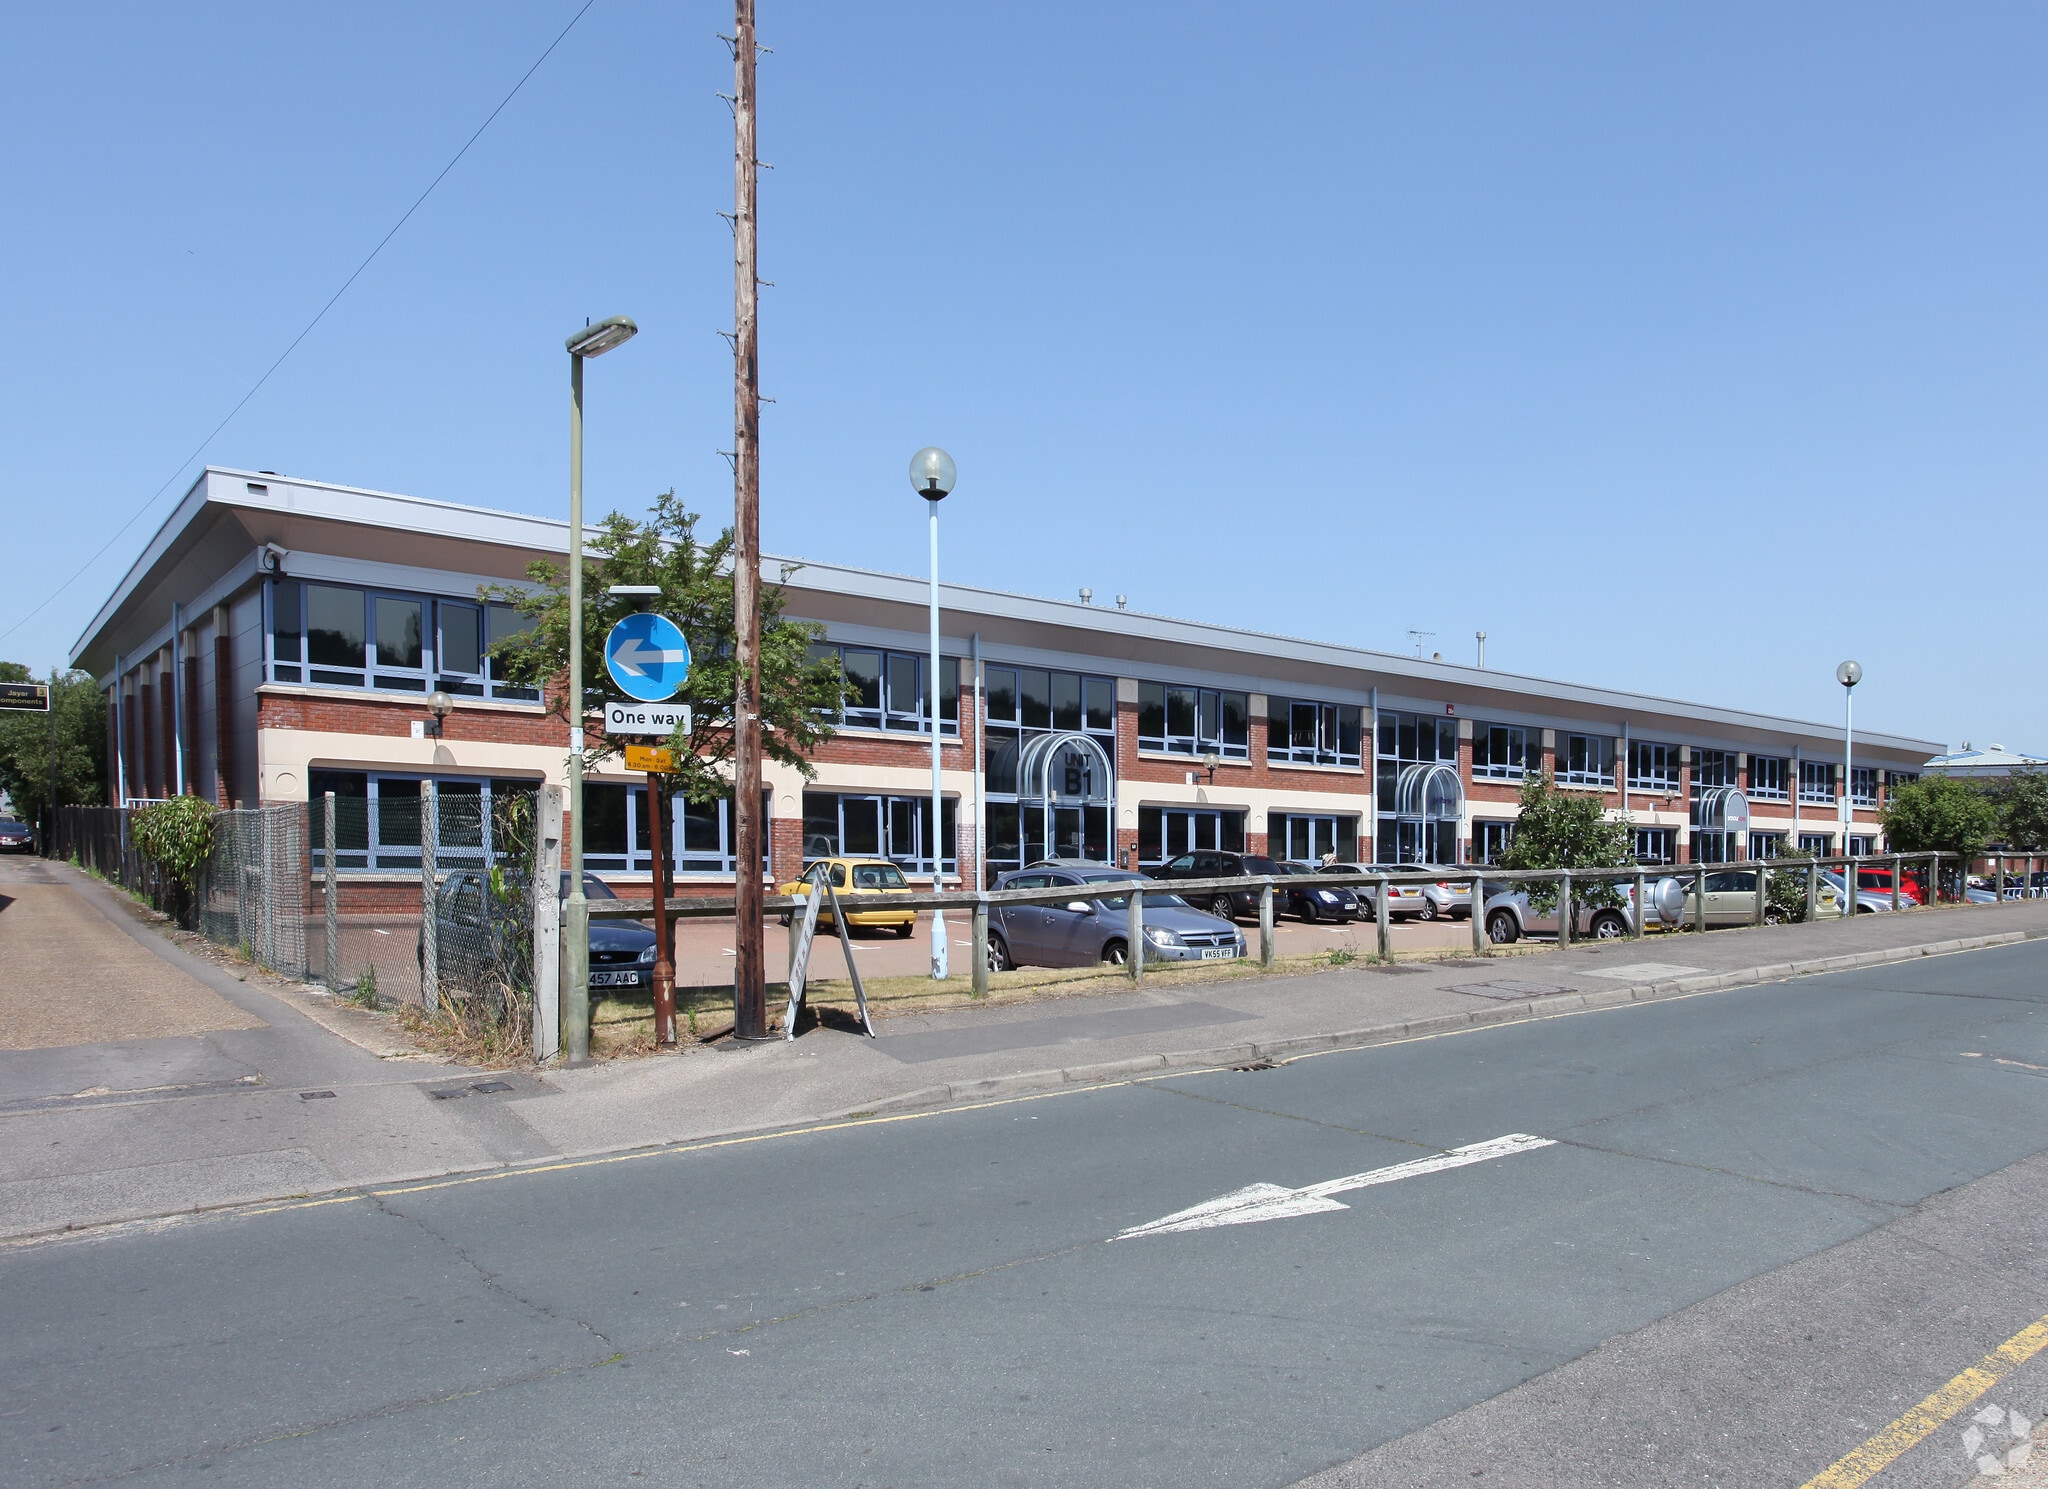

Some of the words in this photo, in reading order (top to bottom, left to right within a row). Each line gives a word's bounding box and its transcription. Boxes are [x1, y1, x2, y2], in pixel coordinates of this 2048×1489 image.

[612, 710, 645, 723] One
[1065, 753, 1090, 766] UNIT
[1065, 768, 1091, 795] B1
[590, 974, 611, 984] 457
[616, 973, 637, 983] AAC
